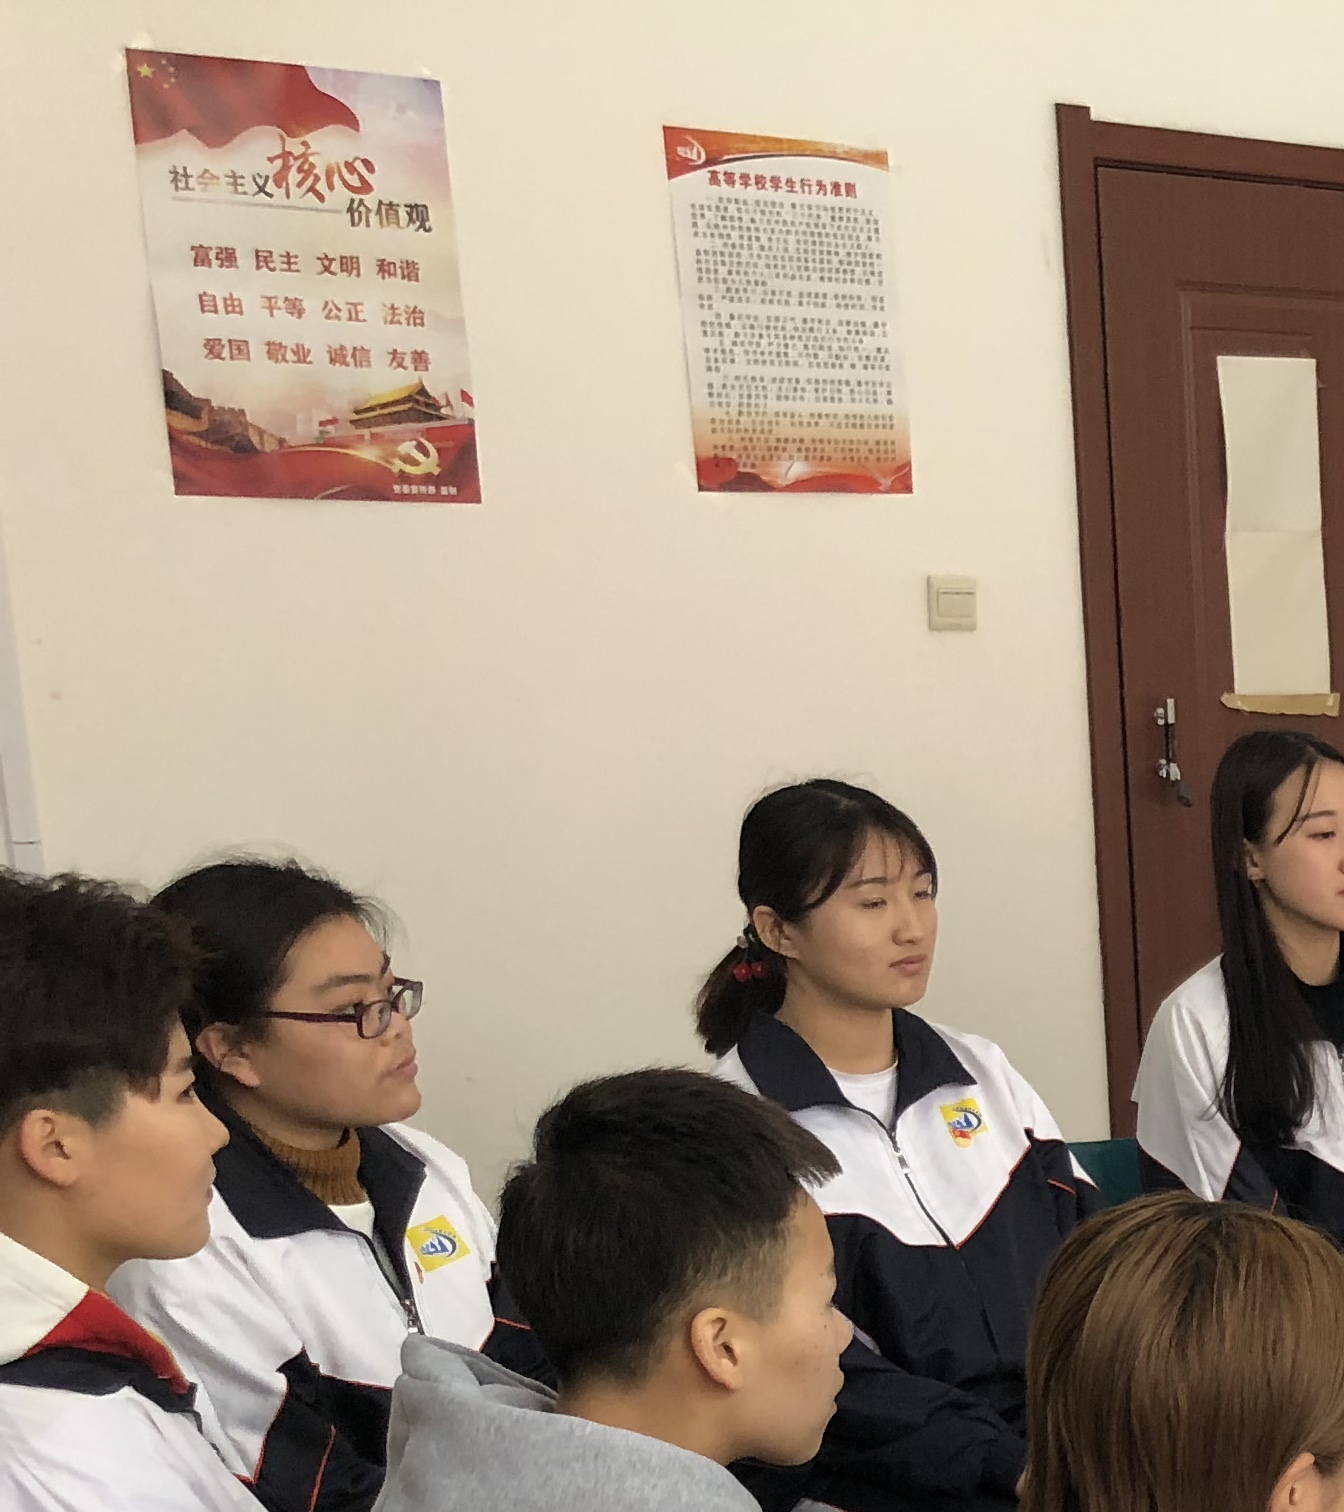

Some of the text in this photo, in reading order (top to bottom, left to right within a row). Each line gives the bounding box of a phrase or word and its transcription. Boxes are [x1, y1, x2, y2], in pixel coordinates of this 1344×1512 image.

[707, 170, 857, 199] 高等学校学生行为准则
[346, 199, 432, 233] 价值观
[190, 243, 420, 283] 富强 民主 文明 和谐
[197, 292, 425, 328] 自由 平等 公正 法治
[202, 337, 432, 372] 爱国 敬业 诚信 友善
